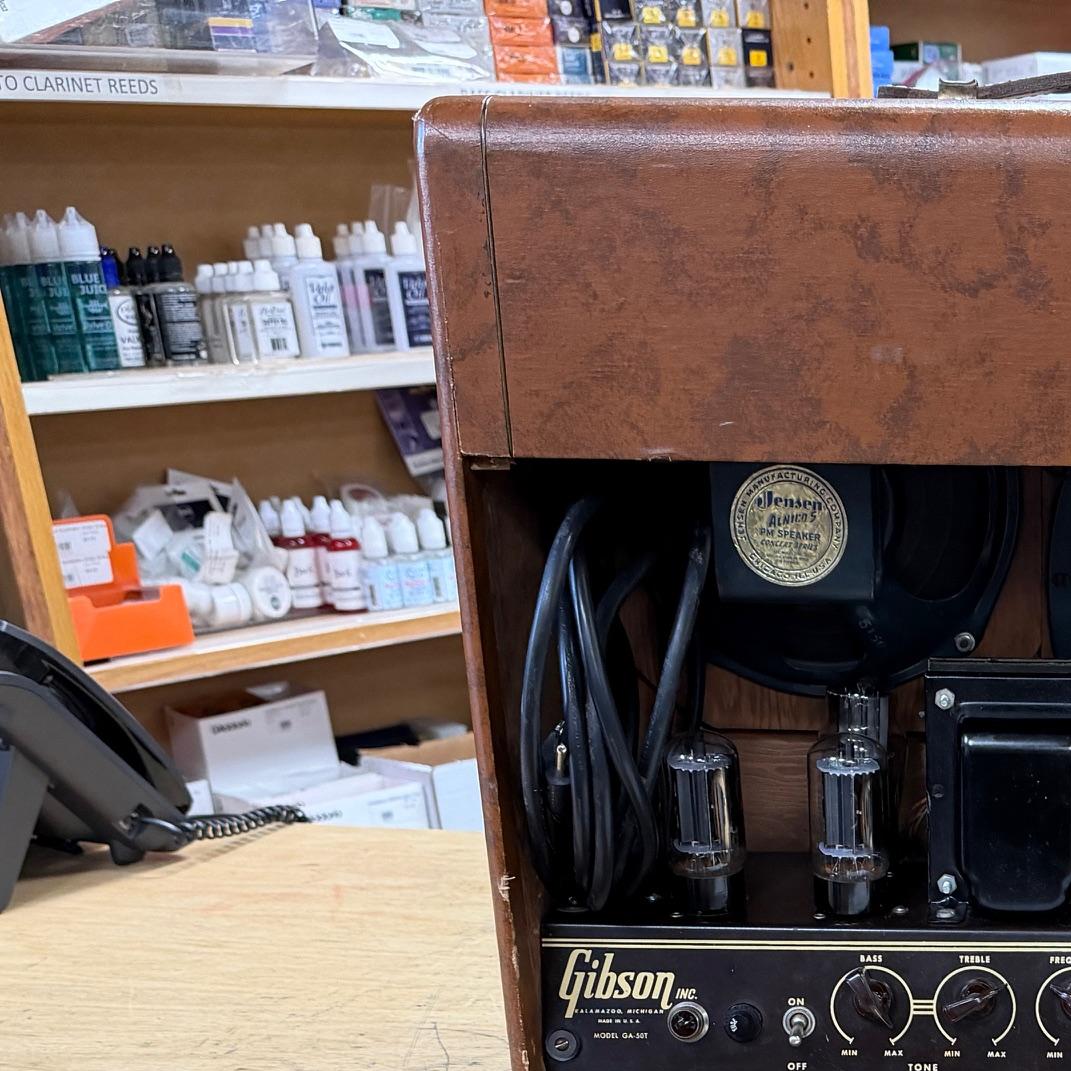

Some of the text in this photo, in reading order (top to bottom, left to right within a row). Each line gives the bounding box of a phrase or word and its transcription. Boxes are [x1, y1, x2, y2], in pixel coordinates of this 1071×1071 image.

[23, 75, 102, 93] CLARINET
[108, 78, 159, 95] REEDS
[71, 272, 100, 285] BLUE
[79, 284, 108, 296] JUIC
[754, 490, 823, 512] Jensen
[746, 471, 827, 497] MANUFACTURING
[826, 496, 842, 550] COMPANY
[760, 528, 821, 541] PM SPEAKER
[859, 954, 883, 963] BASS
[958, 954, 991, 964] TREBLE
[558, 948, 676, 1019] Gibson
[675, 987, 698, 1000] INC.
[787, 996, 806, 1007] ON
[883, 1049, 904, 1057] MAX
[943, 1050, 961, 1058] MIN
[986, 1050, 1007, 1058] MAX
[1046, 1051, 1063, 1059] MIN
[787, 1062, 808, 1071] OFF
[907, 1063, 938, 1071] TONE
